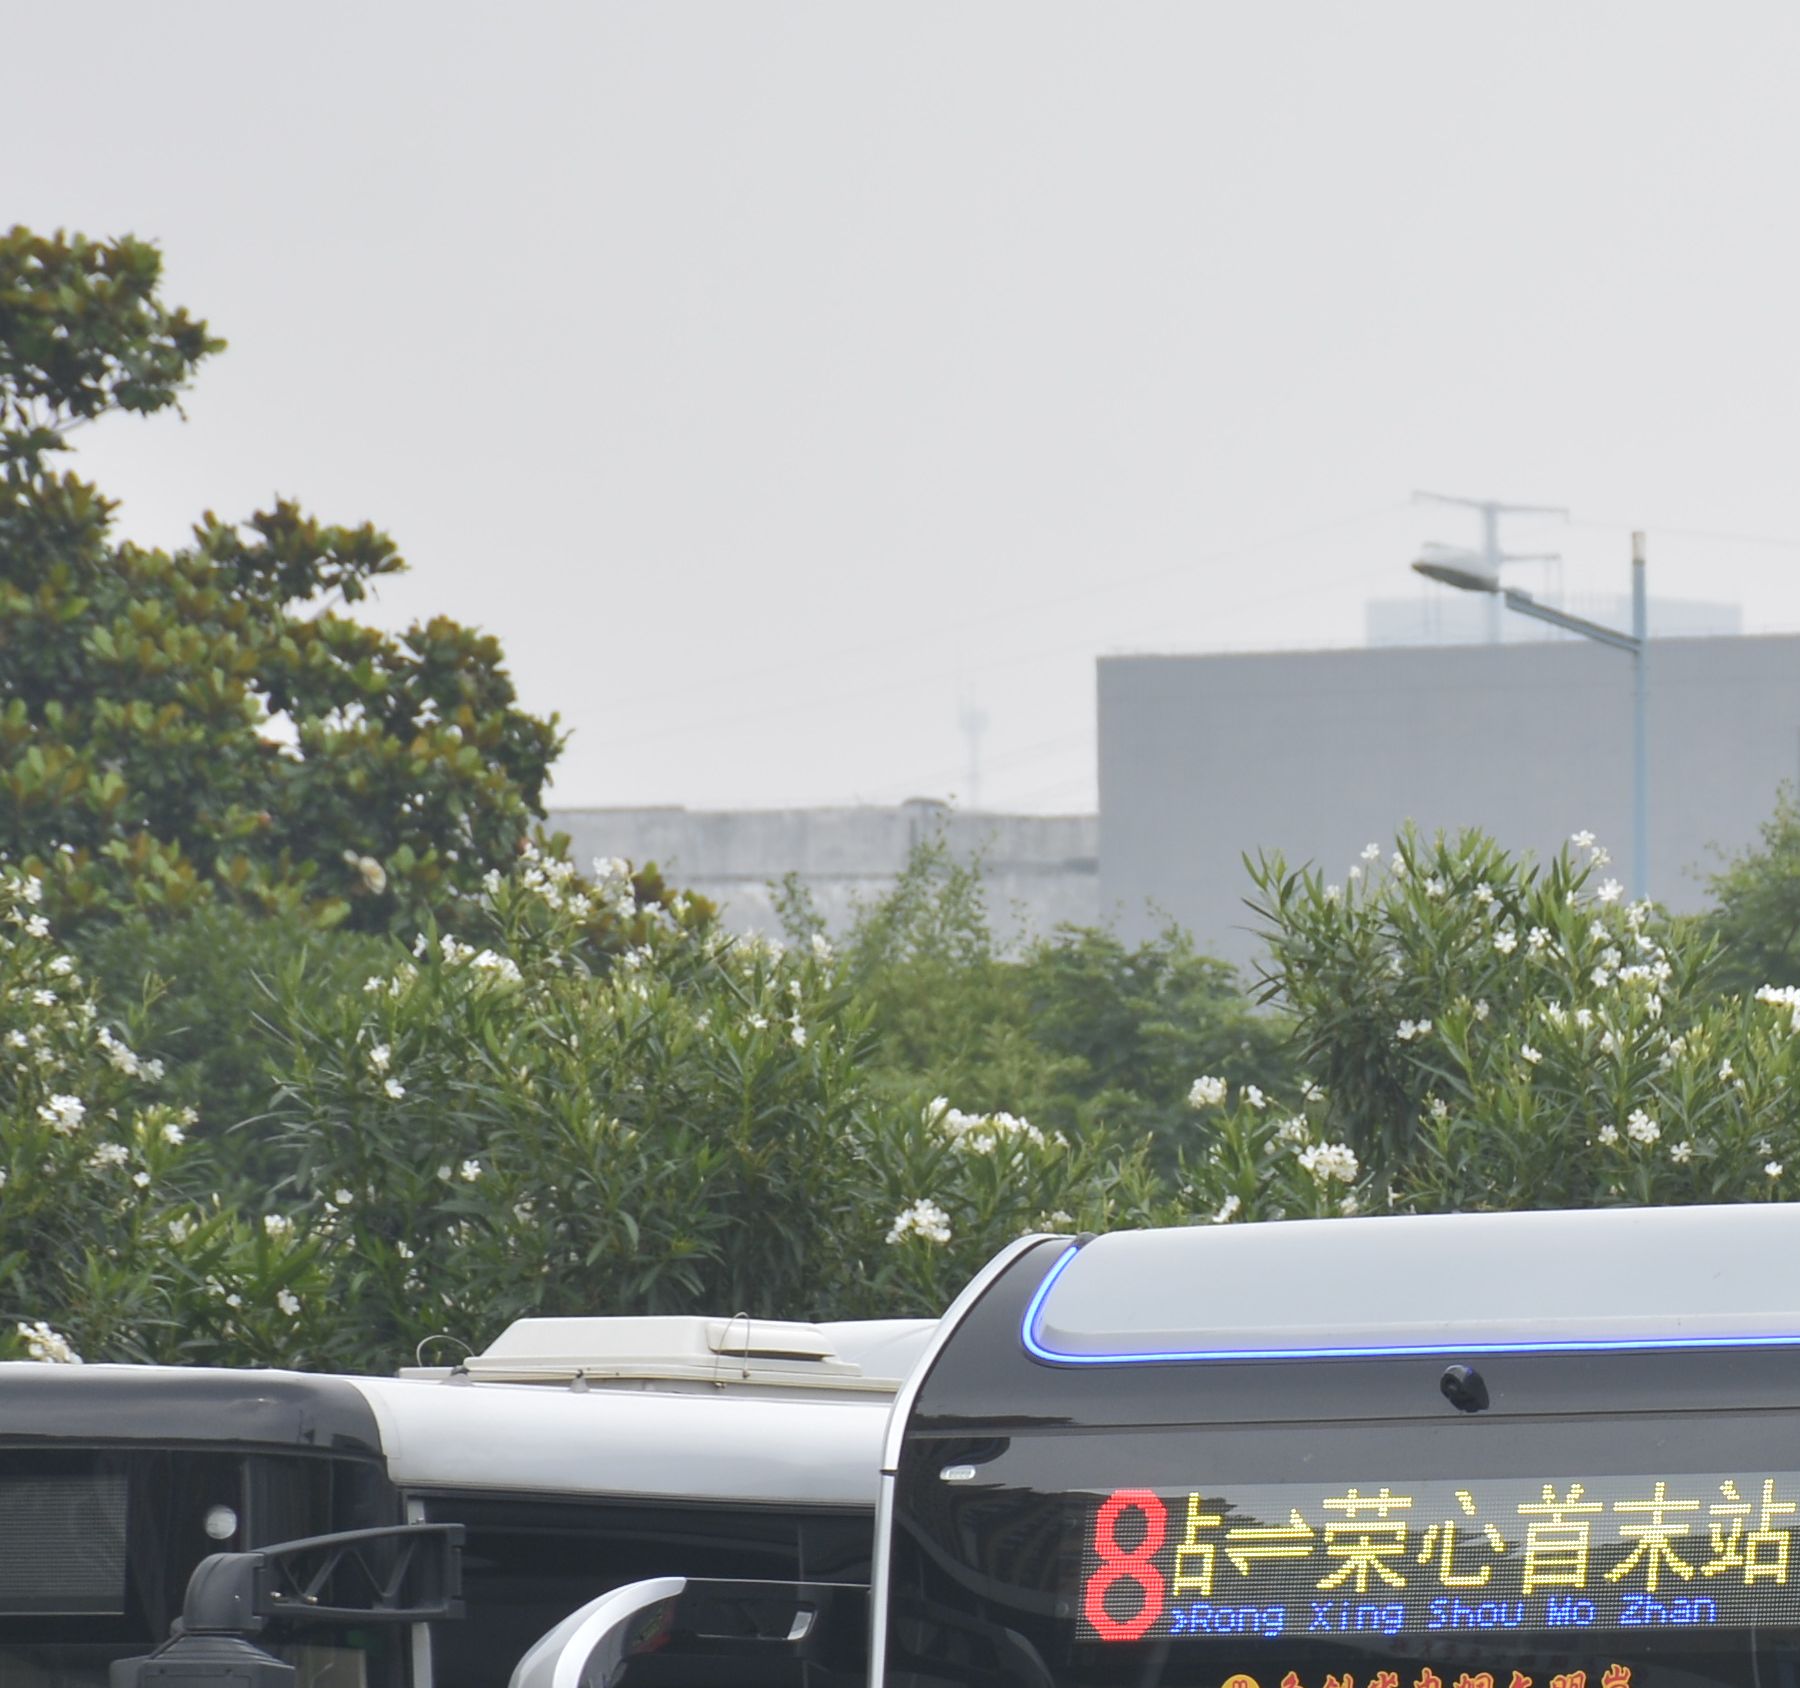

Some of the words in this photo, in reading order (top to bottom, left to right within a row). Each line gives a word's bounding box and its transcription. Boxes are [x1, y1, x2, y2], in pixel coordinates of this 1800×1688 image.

[1085, 1489, 1167, 1641] 8
[1316, 1479, 1797, 1595] 荣心首末站
[1308, 1600, 1406, 1635] Xing
[1428, 1596, 1525, 1629] Shou
[1547, 1595, 1597, 1627] Mo
[1619, 1592, 1718, 1627] Zhan
